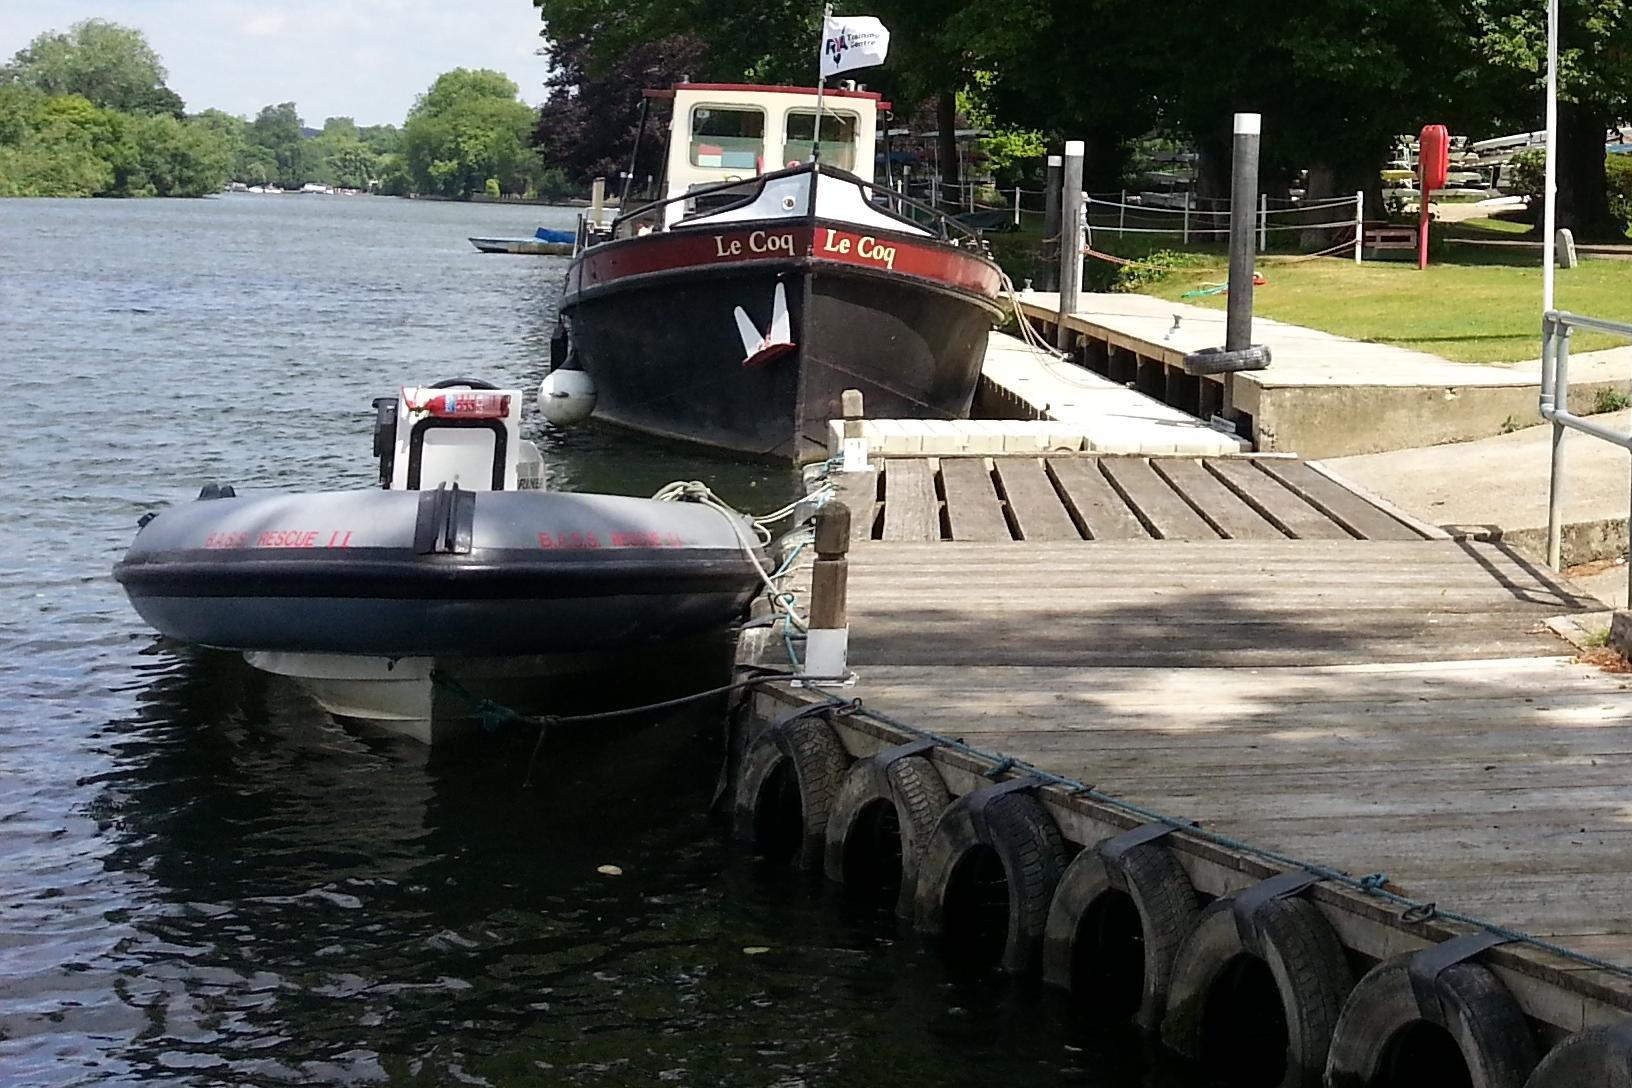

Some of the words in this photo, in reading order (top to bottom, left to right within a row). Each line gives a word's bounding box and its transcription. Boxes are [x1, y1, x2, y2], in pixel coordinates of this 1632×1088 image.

[714, 235, 742, 257] Le
[749, 230, 795, 256] Coq
[824, 228, 851, 254] Le
[857, 236, 896, 270] Coq
[256, 530, 319, 548] RESCUE
